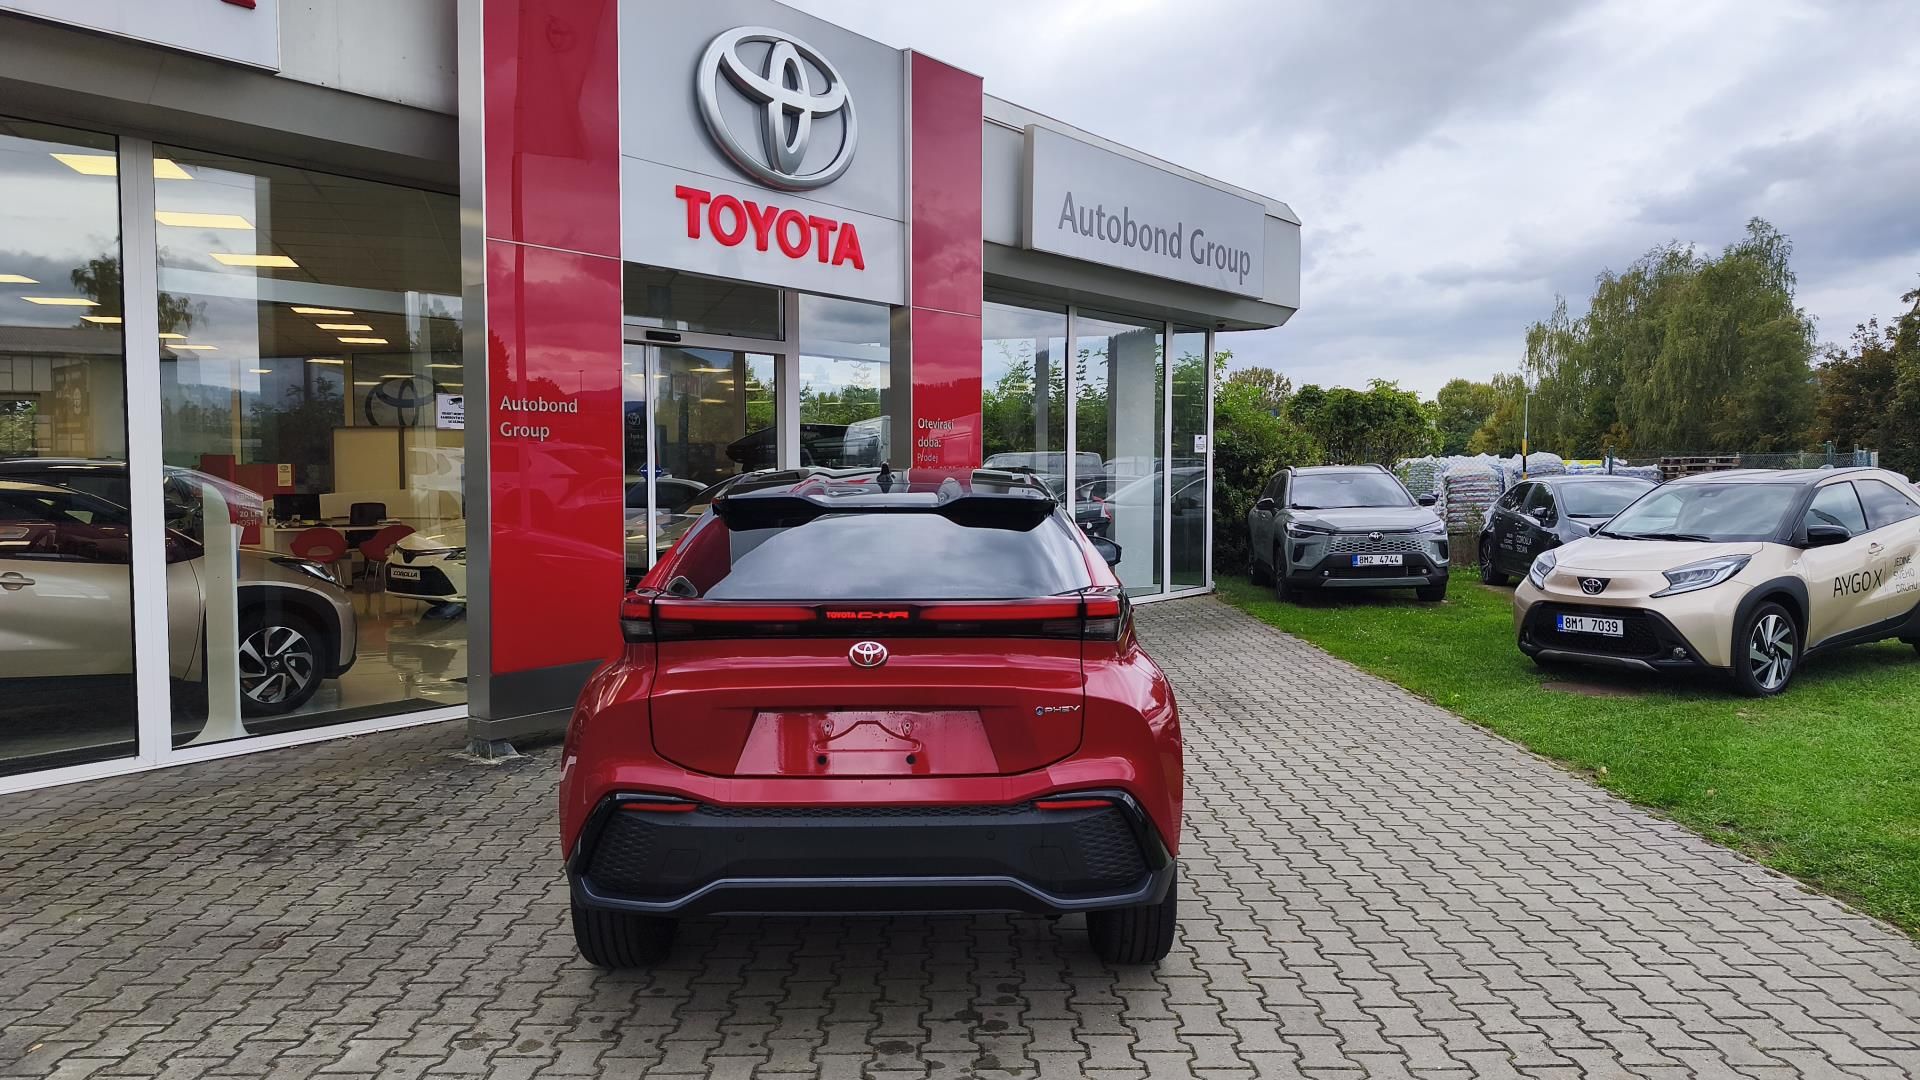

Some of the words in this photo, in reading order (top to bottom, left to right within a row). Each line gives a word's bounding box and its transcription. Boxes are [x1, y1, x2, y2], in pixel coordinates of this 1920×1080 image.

[675, 184, 865, 271] TOYOTA
[1058, 191, 1183, 259] Autobond
[1189, 228, 1251, 285] Group
[500, 395, 578, 414] Autobond
[500, 421, 550, 442] Group
[917, 435, 942, 448] doba:
[1359, 555, 1374, 564] 8M2
[1379, 555, 1399, 564] 4744
[1833, 571, 1871, 598] AYGO
[1872, 568, 1883, 589] X
[826, 611, 857, 619] TOYOTA
[1565, 617, 1584, 630] 8M1
[1591, 619, 1618, 633] 7039
